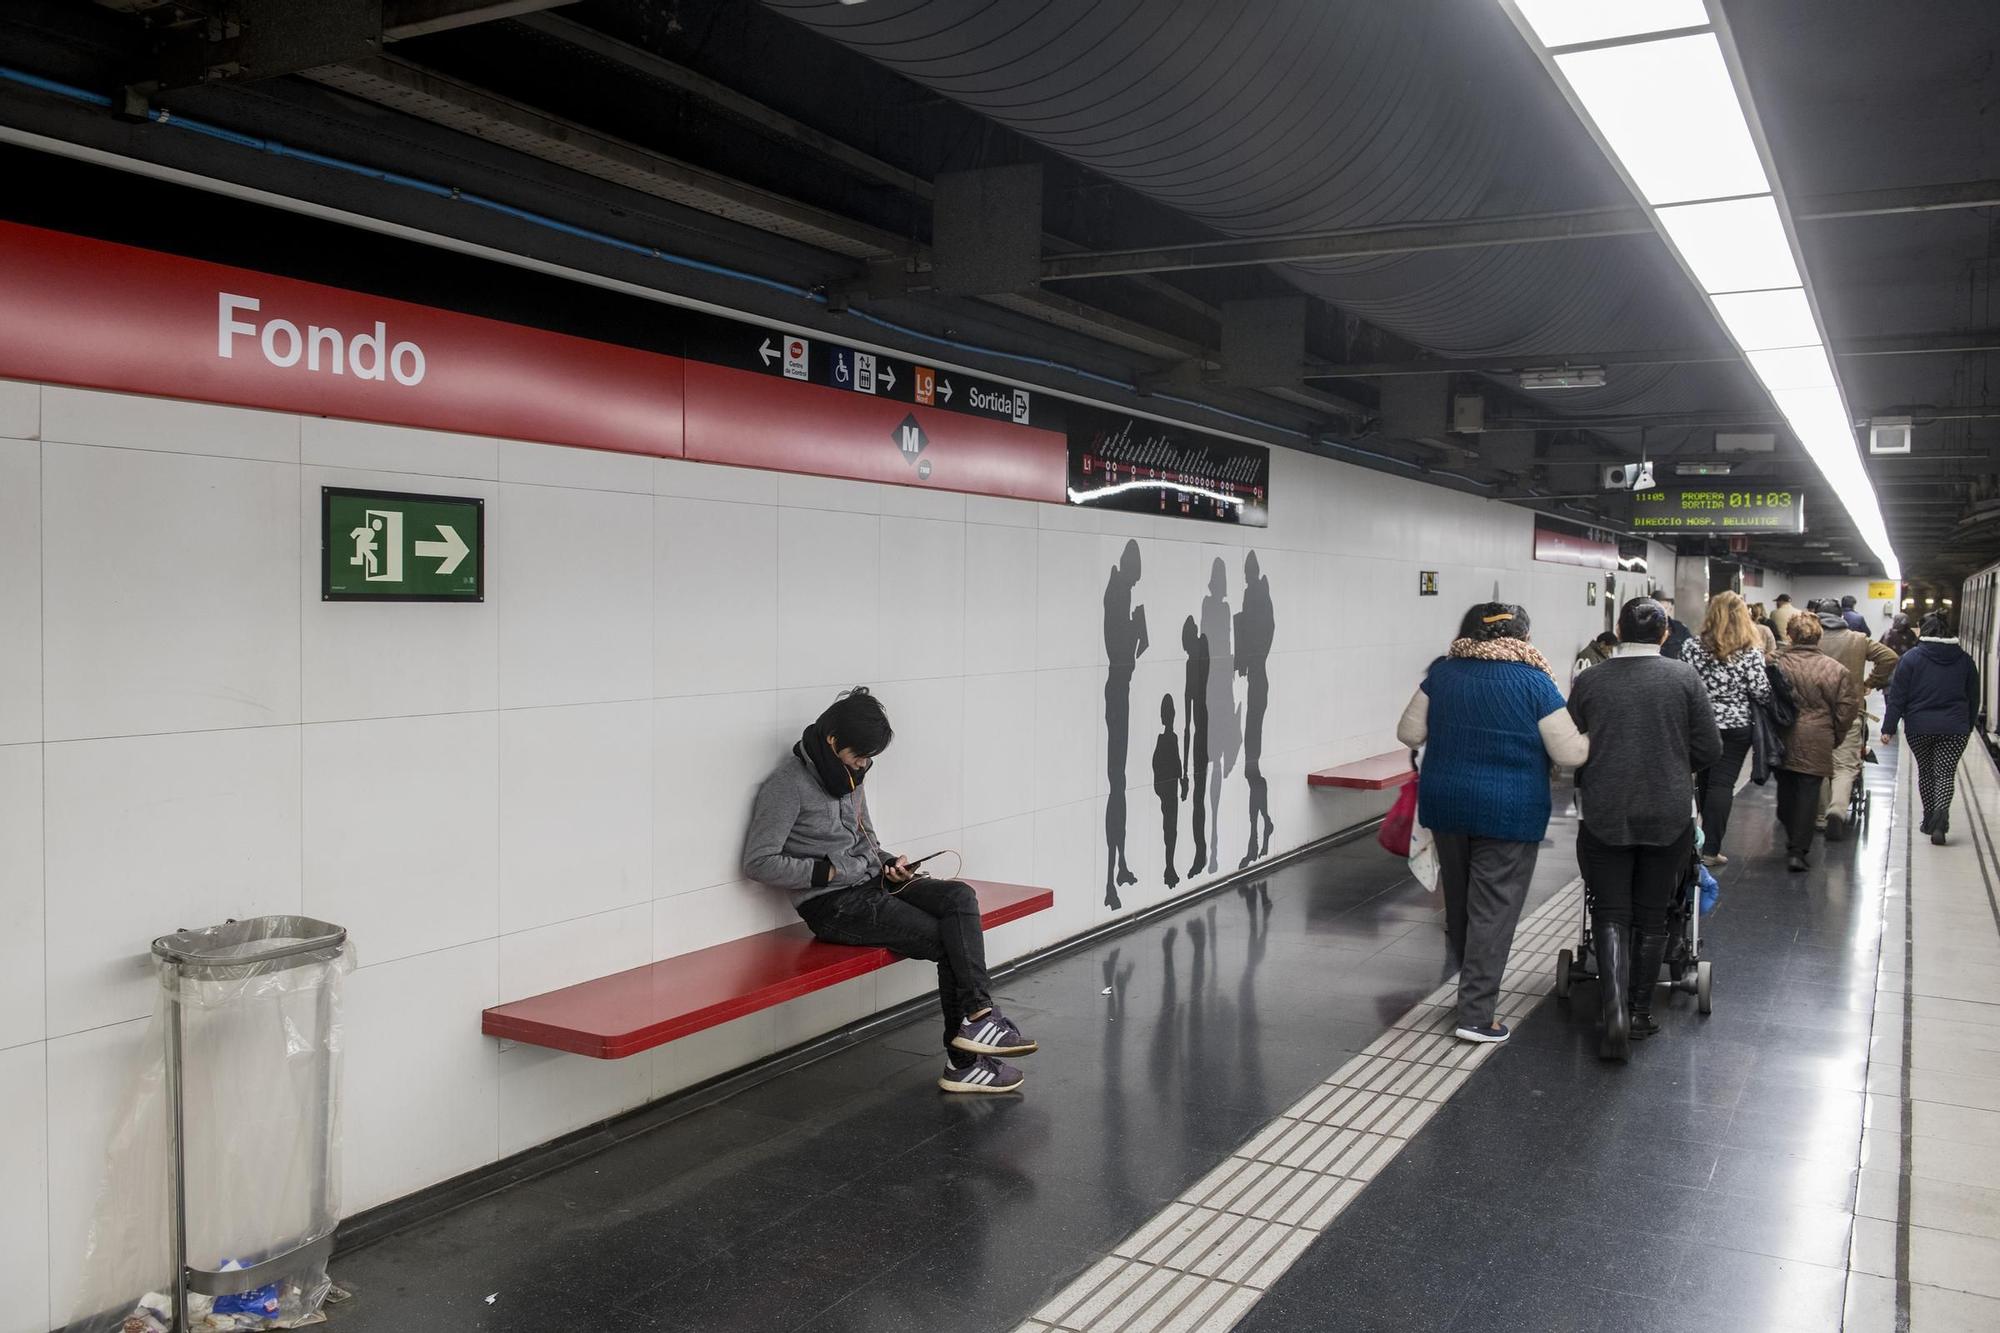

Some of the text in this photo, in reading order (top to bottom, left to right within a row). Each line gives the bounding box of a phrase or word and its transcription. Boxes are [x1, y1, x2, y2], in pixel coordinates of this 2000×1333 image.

[217, 292, 427, 388] Fondo
[791, 369, 807, 377] Control
[916, 374, 934, 396] L9
[969, 387, 1012, 415] Sortida
[902, 425, 919, 453] M
[1083, 458, 1092, 471] L1
[1636, 493, 1665, 502] 11:05
[1681, 492, 1725, 501] PROPERA
[1729, 492, 1792, 508] 01:03
[1681, 501, 1725, 510] SORTIDA
[1634, 517, 1682, 527] DIRECCIO
[1723, 517, 1778, 526] BELLVITGE
